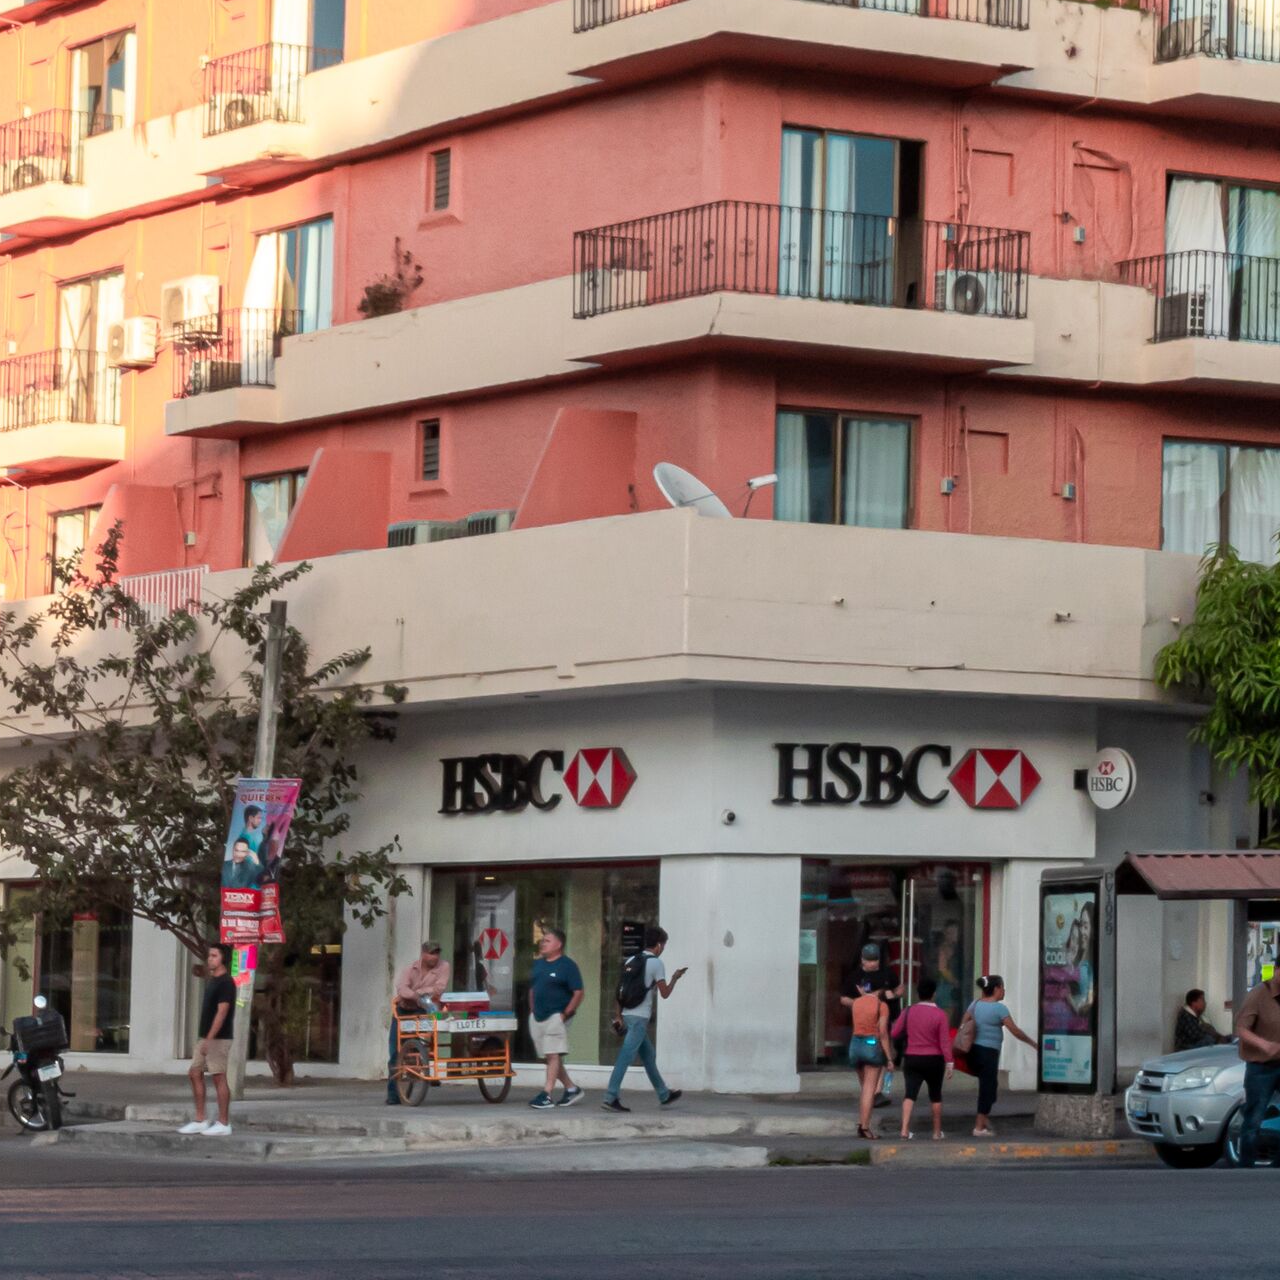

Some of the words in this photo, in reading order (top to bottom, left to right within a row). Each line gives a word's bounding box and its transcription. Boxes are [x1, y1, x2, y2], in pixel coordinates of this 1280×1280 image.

[438, 749, 564, 814] HSBC
[772, 742, 951, 806] HSBC
[1090, 776, 1123, 792] HSBC
